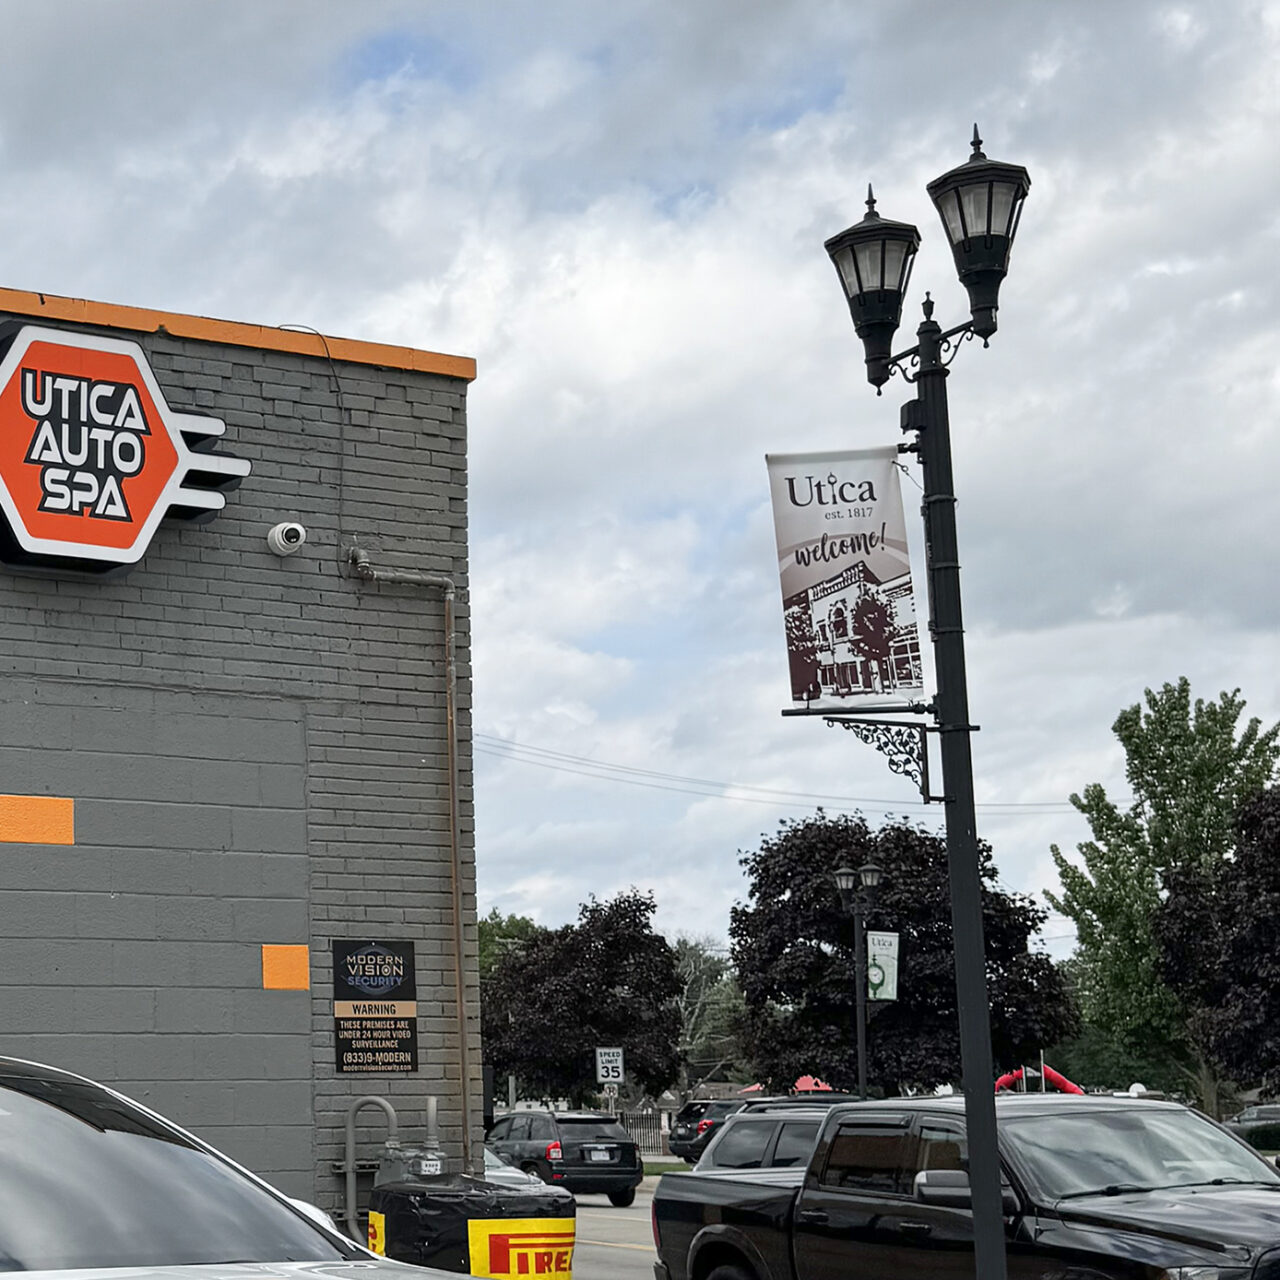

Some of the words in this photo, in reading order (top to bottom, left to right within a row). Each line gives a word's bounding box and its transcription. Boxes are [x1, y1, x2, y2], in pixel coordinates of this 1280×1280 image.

[24, 370, 149, 431] UTICA
[29, 419, 142, 474] AUTO
[42, 469, 128, 518] SPA
[784, 472, 878, 507] Utica
[824, 509, 844, 520] est.
[847, 507, 873, 519] 1817
[795, 522, 887, 567] welcome!
[346, 955, 404, 965] MODERN
[347, 964, 404, 976] VISION
[347, 976, 403, 986] SECURITY
[352, 1004, 397, 1015] WARNING
[340, 1021, 361, 1029] THESE
[362, 1021, 395, 1029] PREMISES
[396, 1021, 409, 1029] ARE
[339, 1030, 361, 1039] UNDER
[362, 1030, 371, 1039] 24
[373, 1031, 391, 1039] HOUR
[392, 1031, 411, 1039] VIDEO
[351, 1040, 399, 1048] SURVEILLANCE
[343, 1052, 412, 1064] (833)9-MODERN
[601, 1065, 621, 1079] 35
[488, 1232, 575, 1274] PIRE
